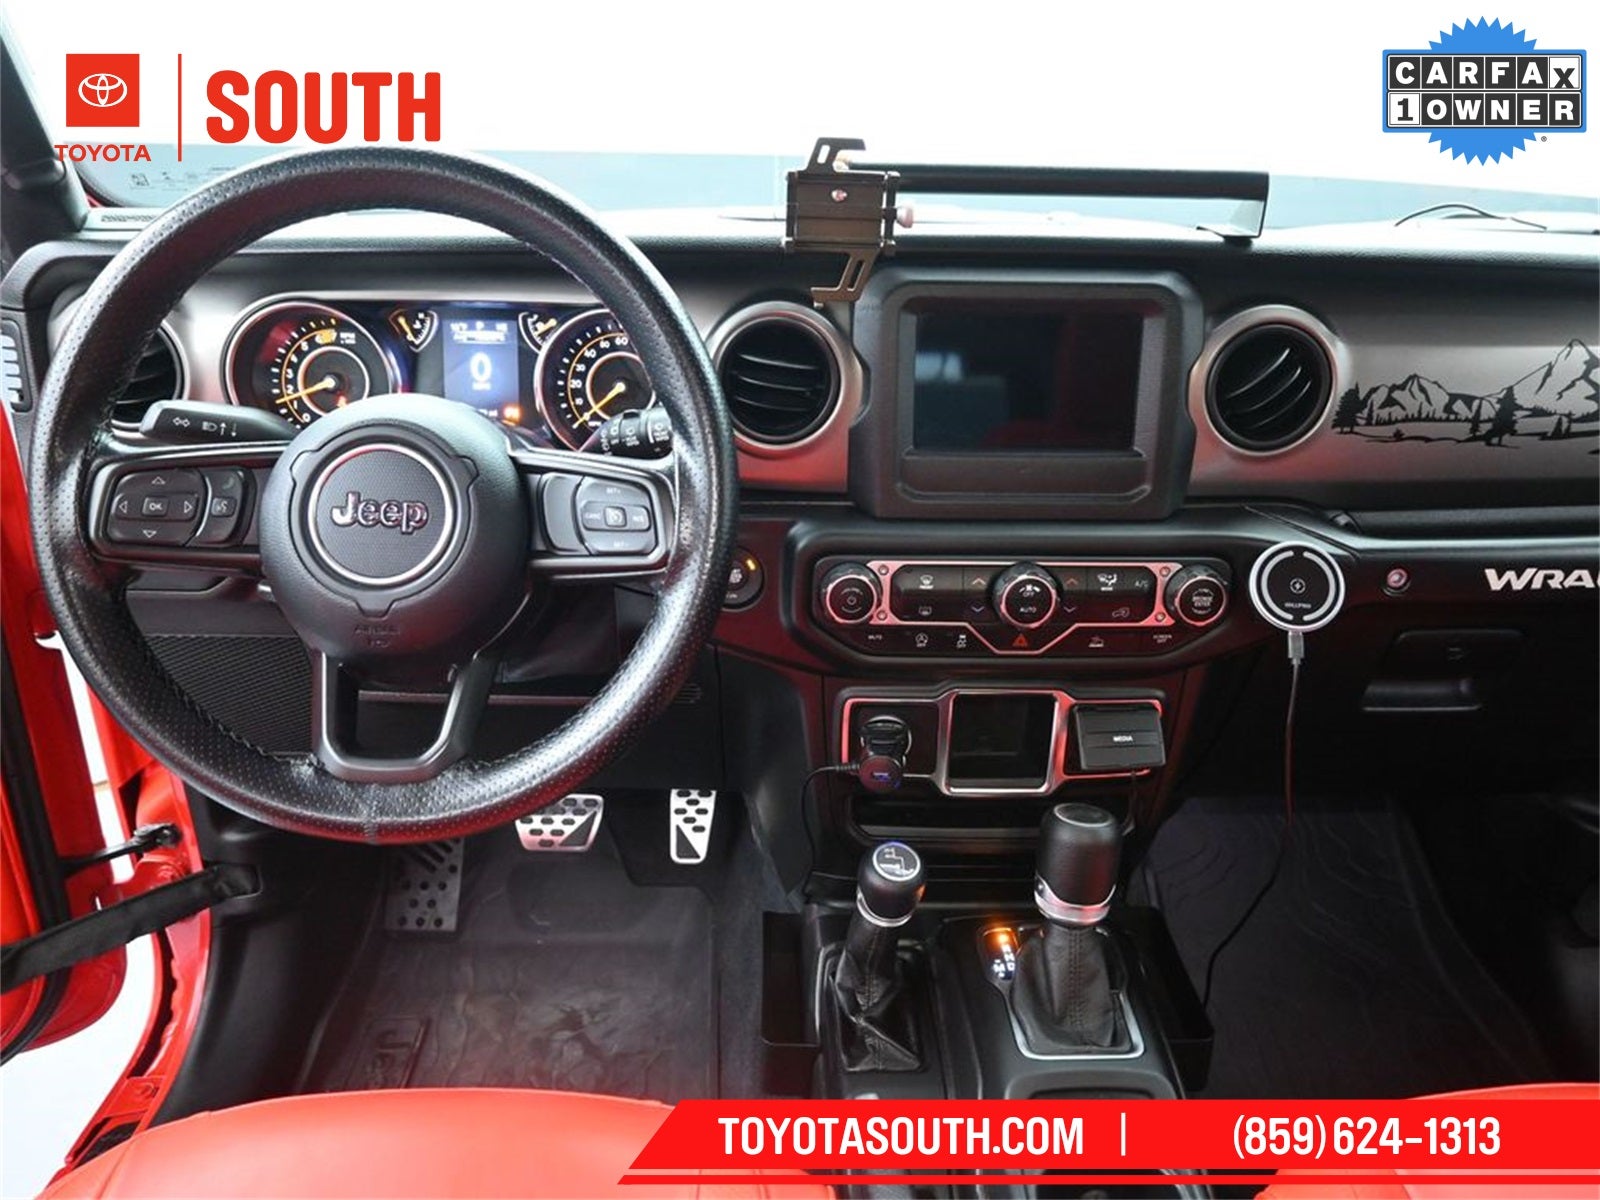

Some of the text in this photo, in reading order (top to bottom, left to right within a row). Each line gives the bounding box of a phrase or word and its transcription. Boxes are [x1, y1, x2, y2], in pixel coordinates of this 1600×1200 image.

[470, 352, 493, 382] 0
[331, 491, 430, 535] Jeep
[1484, 567, 1600, 591] WRA
